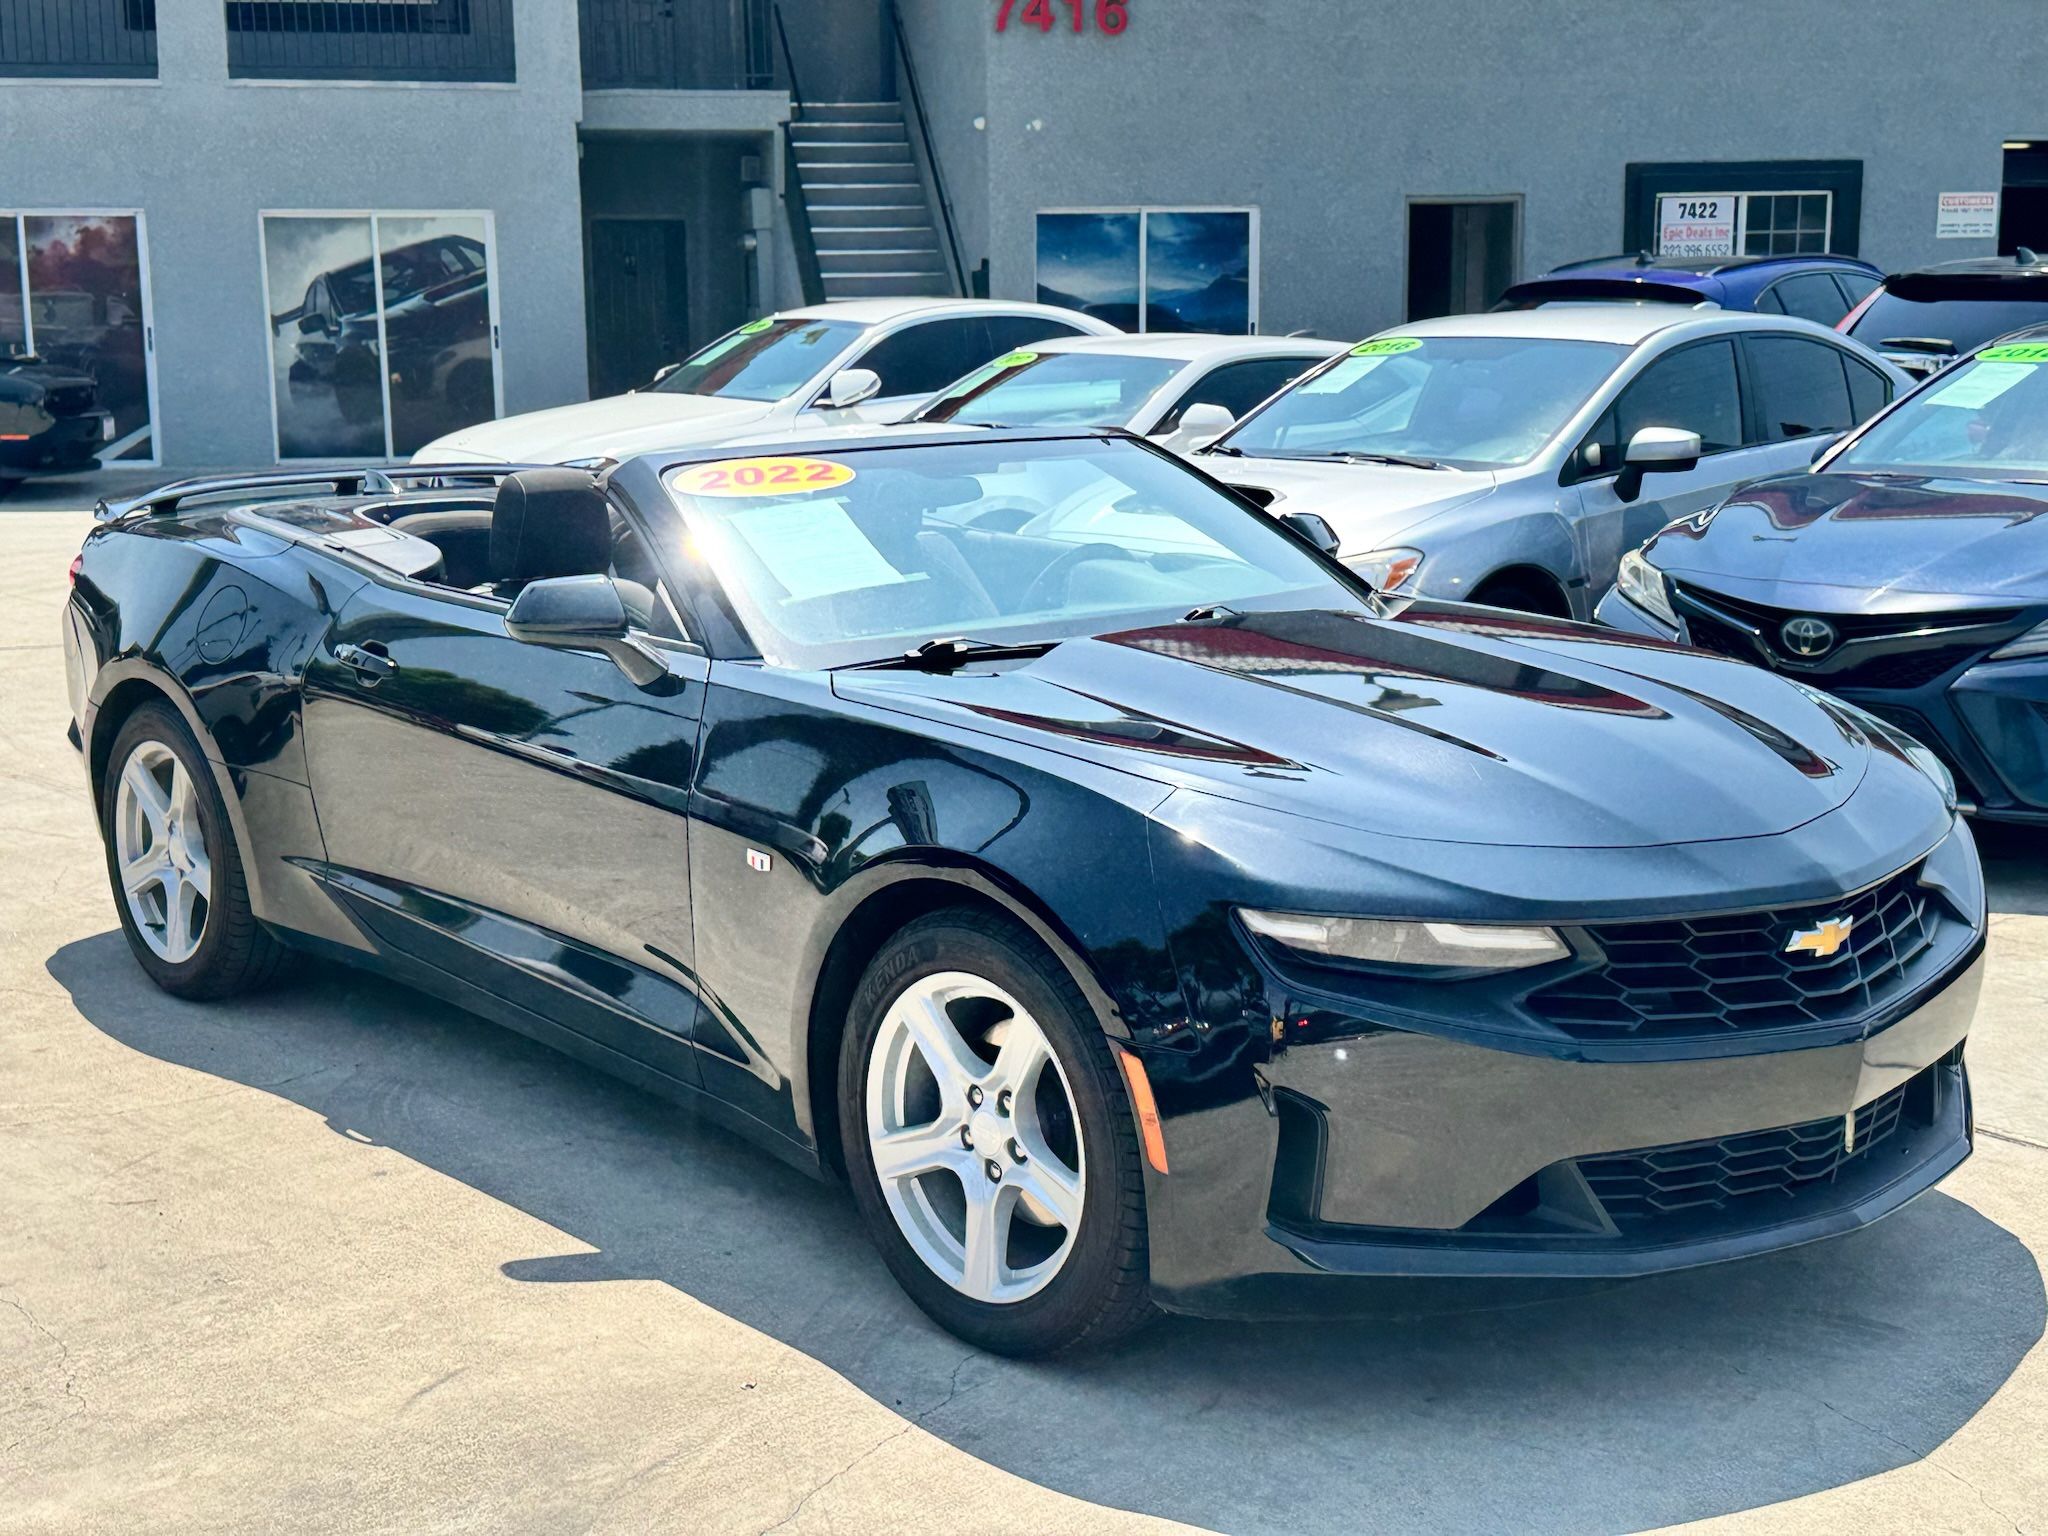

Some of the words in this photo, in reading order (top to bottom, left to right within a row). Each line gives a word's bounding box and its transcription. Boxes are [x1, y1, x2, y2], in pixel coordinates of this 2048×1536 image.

[995, 0, 1128, 35] 7416
[1678, 202, 1718, 219] 7422
[699, 464, 836, 490] 2022
[864, 945, 918, 1007] KENDA
